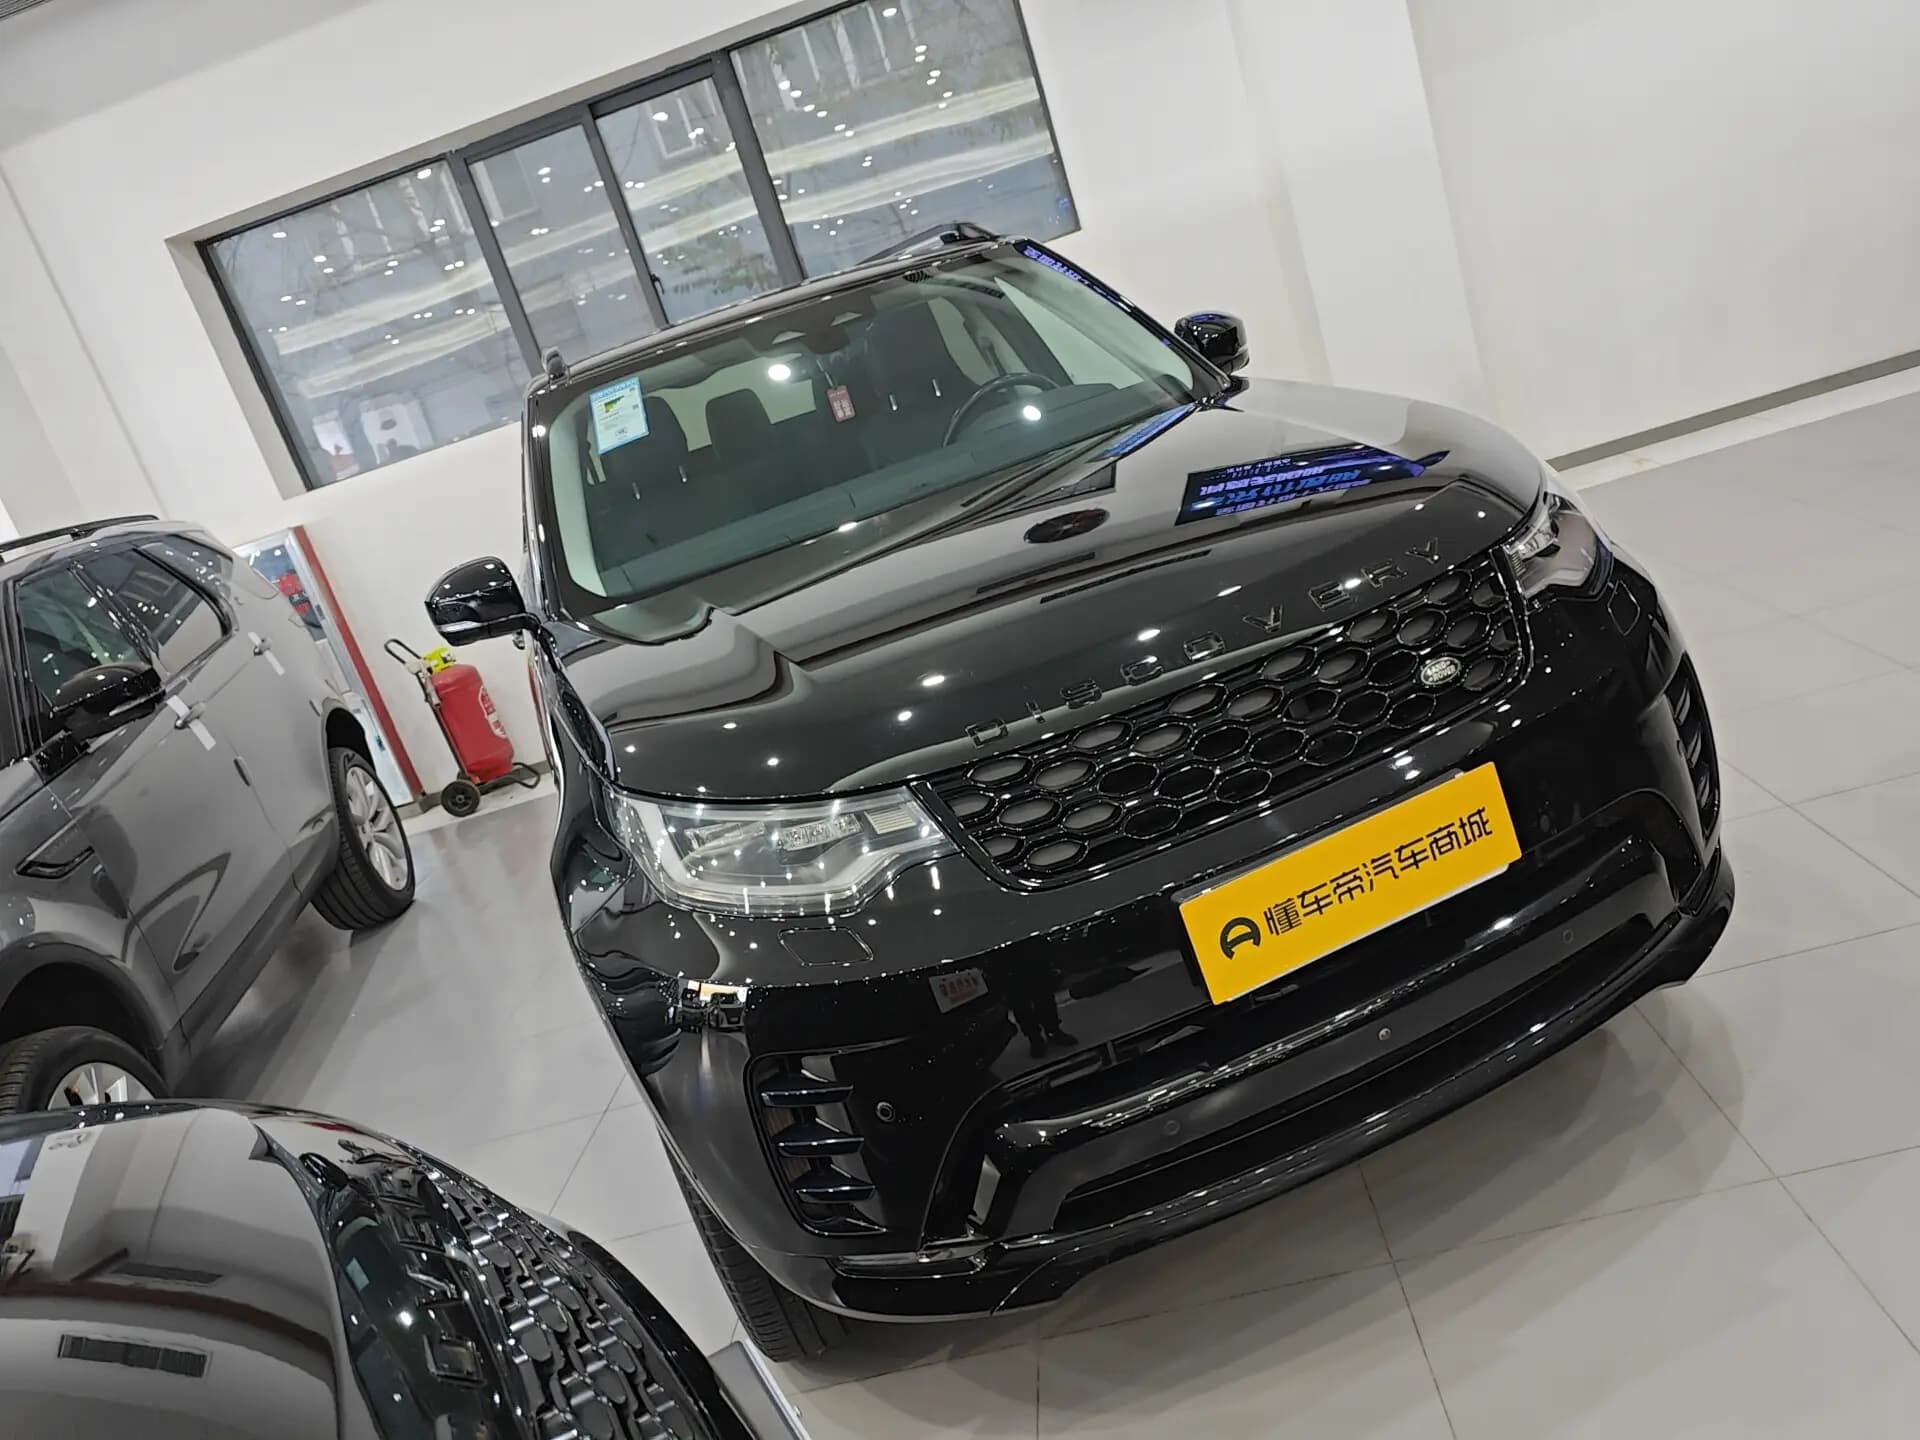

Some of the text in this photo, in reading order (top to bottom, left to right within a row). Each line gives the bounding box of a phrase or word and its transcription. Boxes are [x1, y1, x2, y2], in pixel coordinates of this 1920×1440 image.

[965, 537, 1439, 748] DISCOVERY
[1263, 806, 1493, 937] 懂车帝汽车商城
